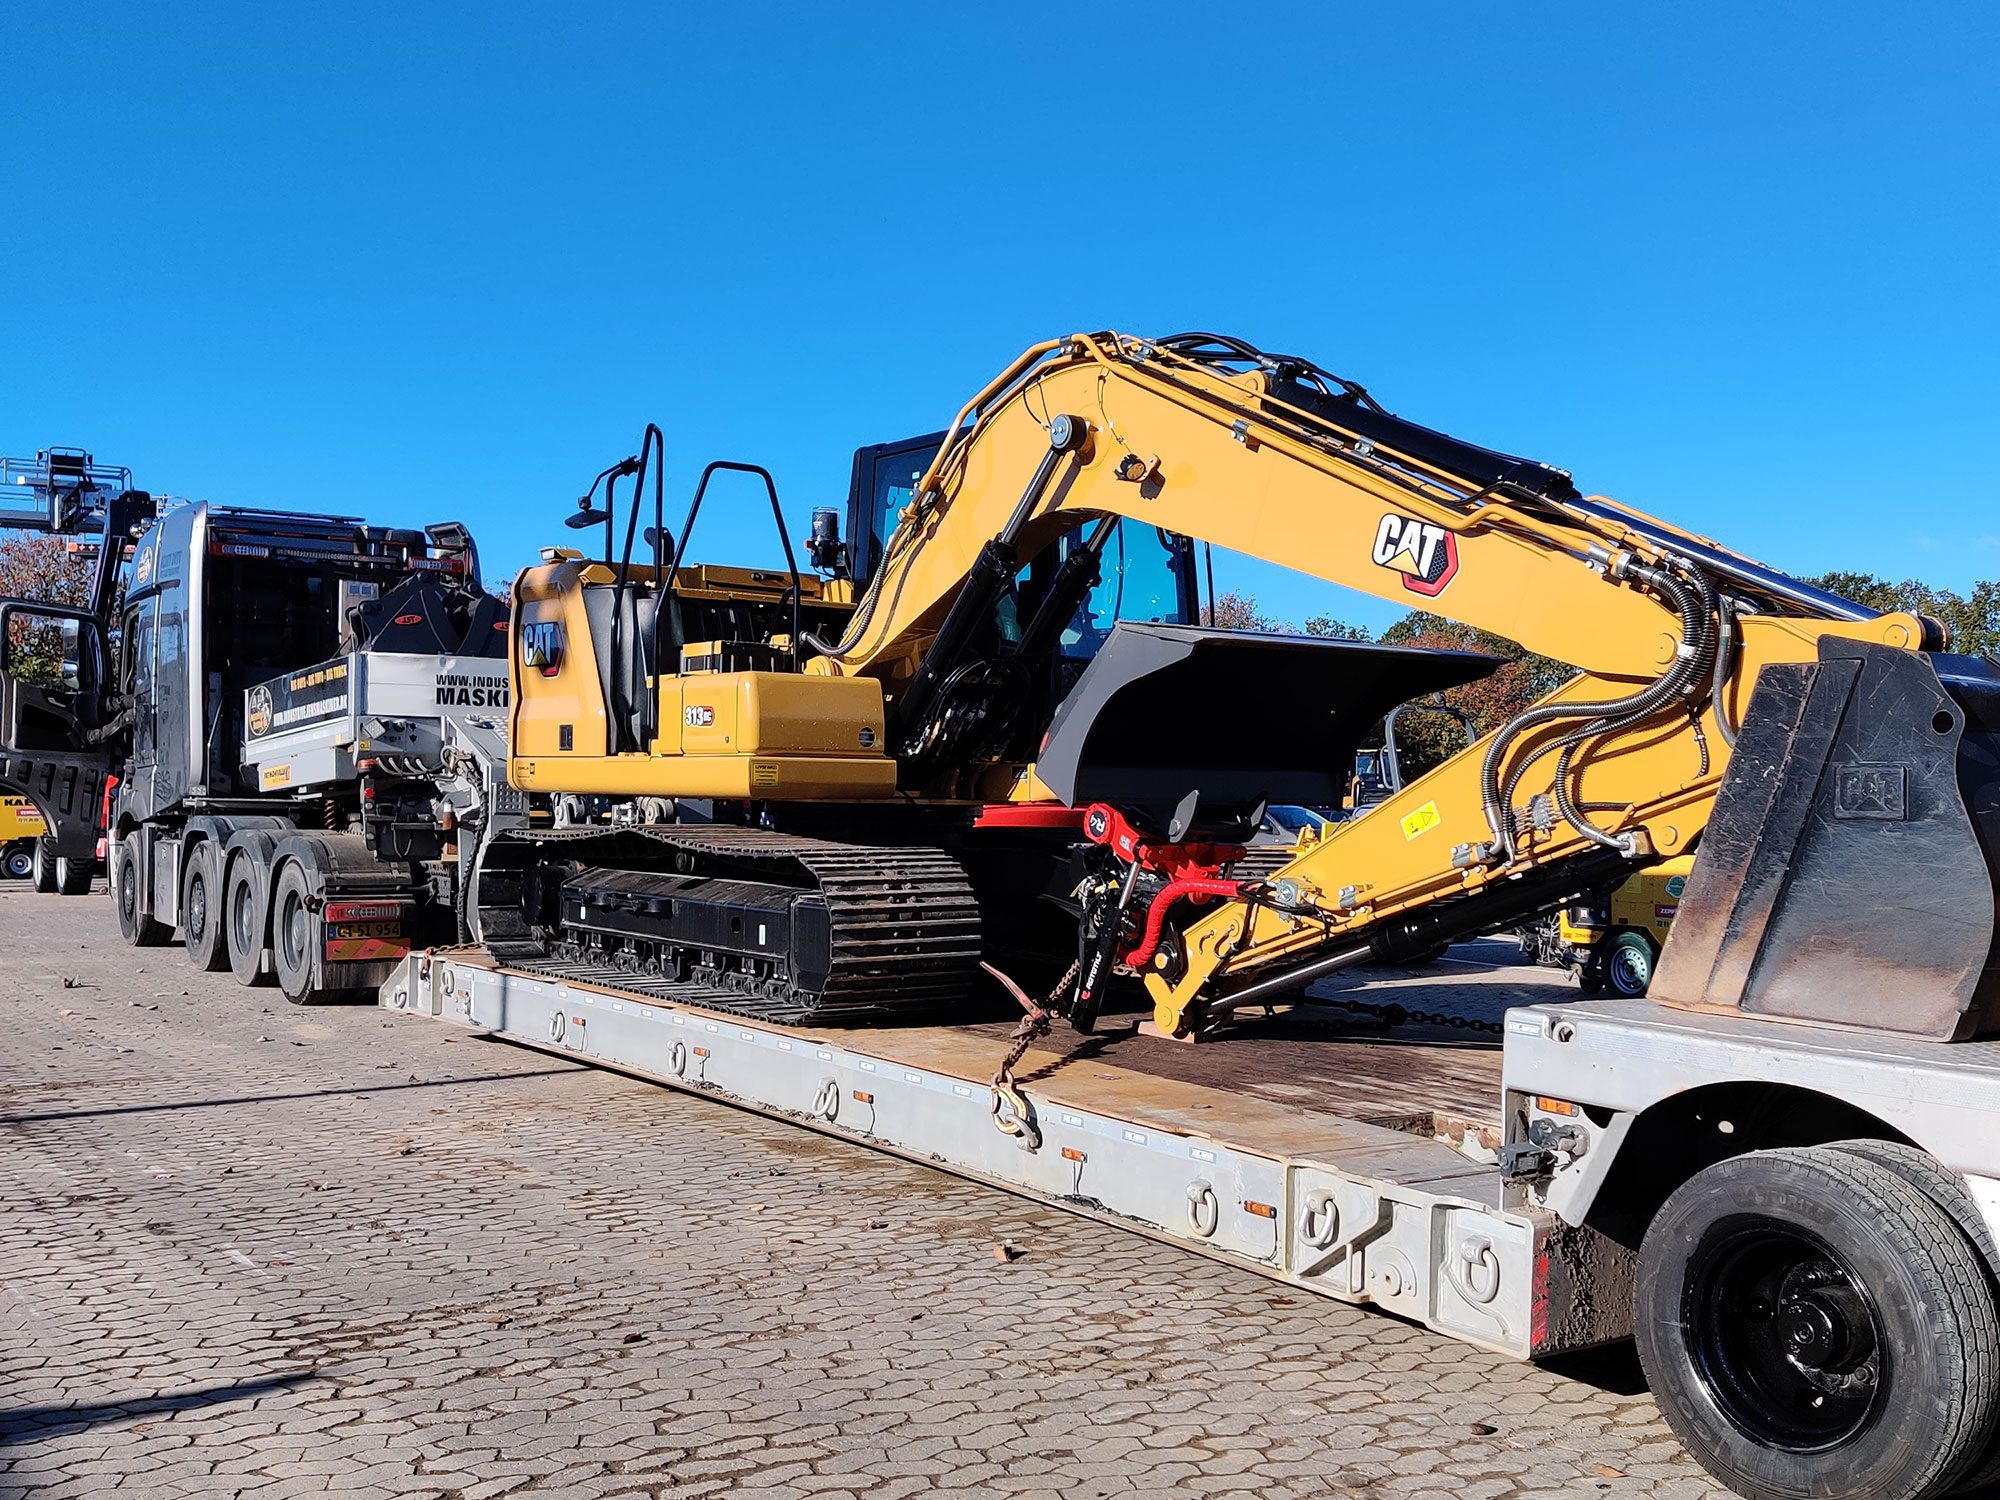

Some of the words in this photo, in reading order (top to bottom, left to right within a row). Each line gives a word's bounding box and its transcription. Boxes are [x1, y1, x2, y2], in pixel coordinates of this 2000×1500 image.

[1373, 513, 1446, 579] CAT
[523, 622, 555, 667] CAT
[436, 674, 509, 689] WWW.INDUS
[436, 688, 509, 707] MASKI
[685, 706, 704, 726] 313
